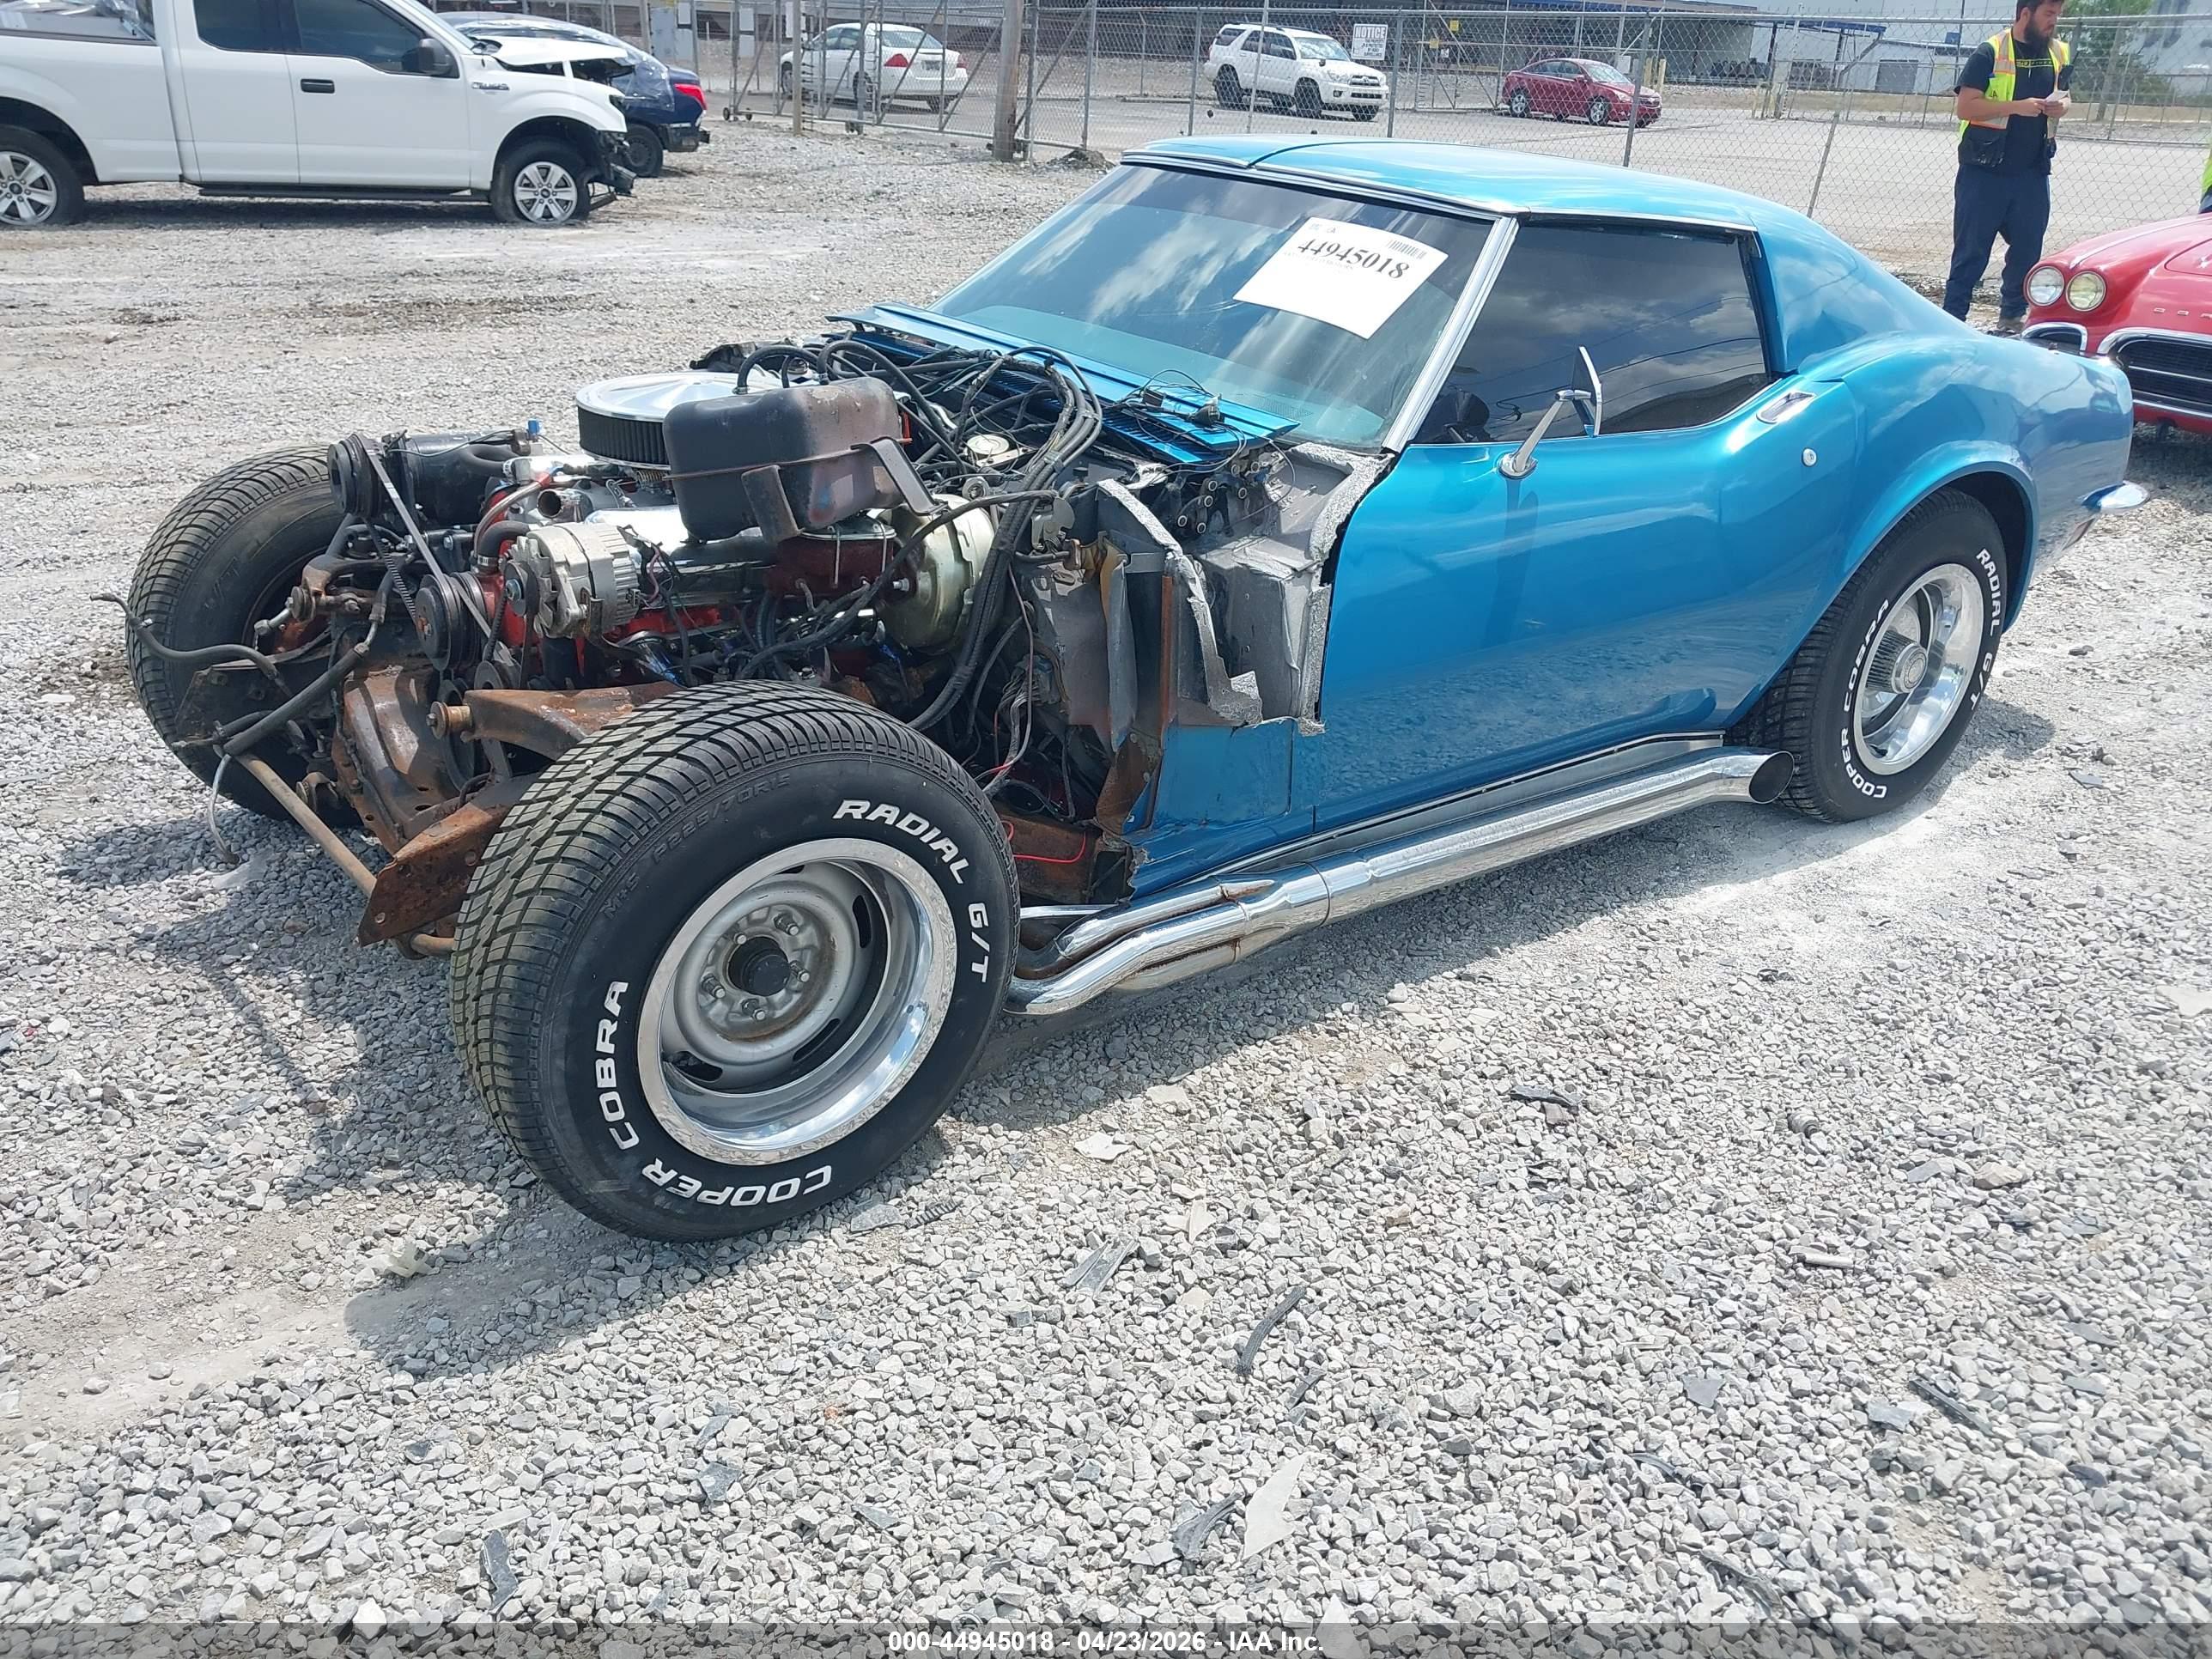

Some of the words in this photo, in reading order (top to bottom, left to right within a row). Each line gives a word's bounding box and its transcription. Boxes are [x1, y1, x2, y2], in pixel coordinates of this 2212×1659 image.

[1354, 27, 1386, 39] NOTICE
[1297, 238, 1410, 279] 44945018
[1976, 548, 2002, 636] RADIAL
[1844, 599, 1889, 713] COBRA
[1970, 652, 1993, 711] G/T
[1841, 727, 1887, 799] COOPER
[832, 799, 969, 884] RADIAL
[968, 902, 991, 983] G/T
[595, 981, 640, 1151] COBRA
[641, 1158, 832, 1206] COOPER
